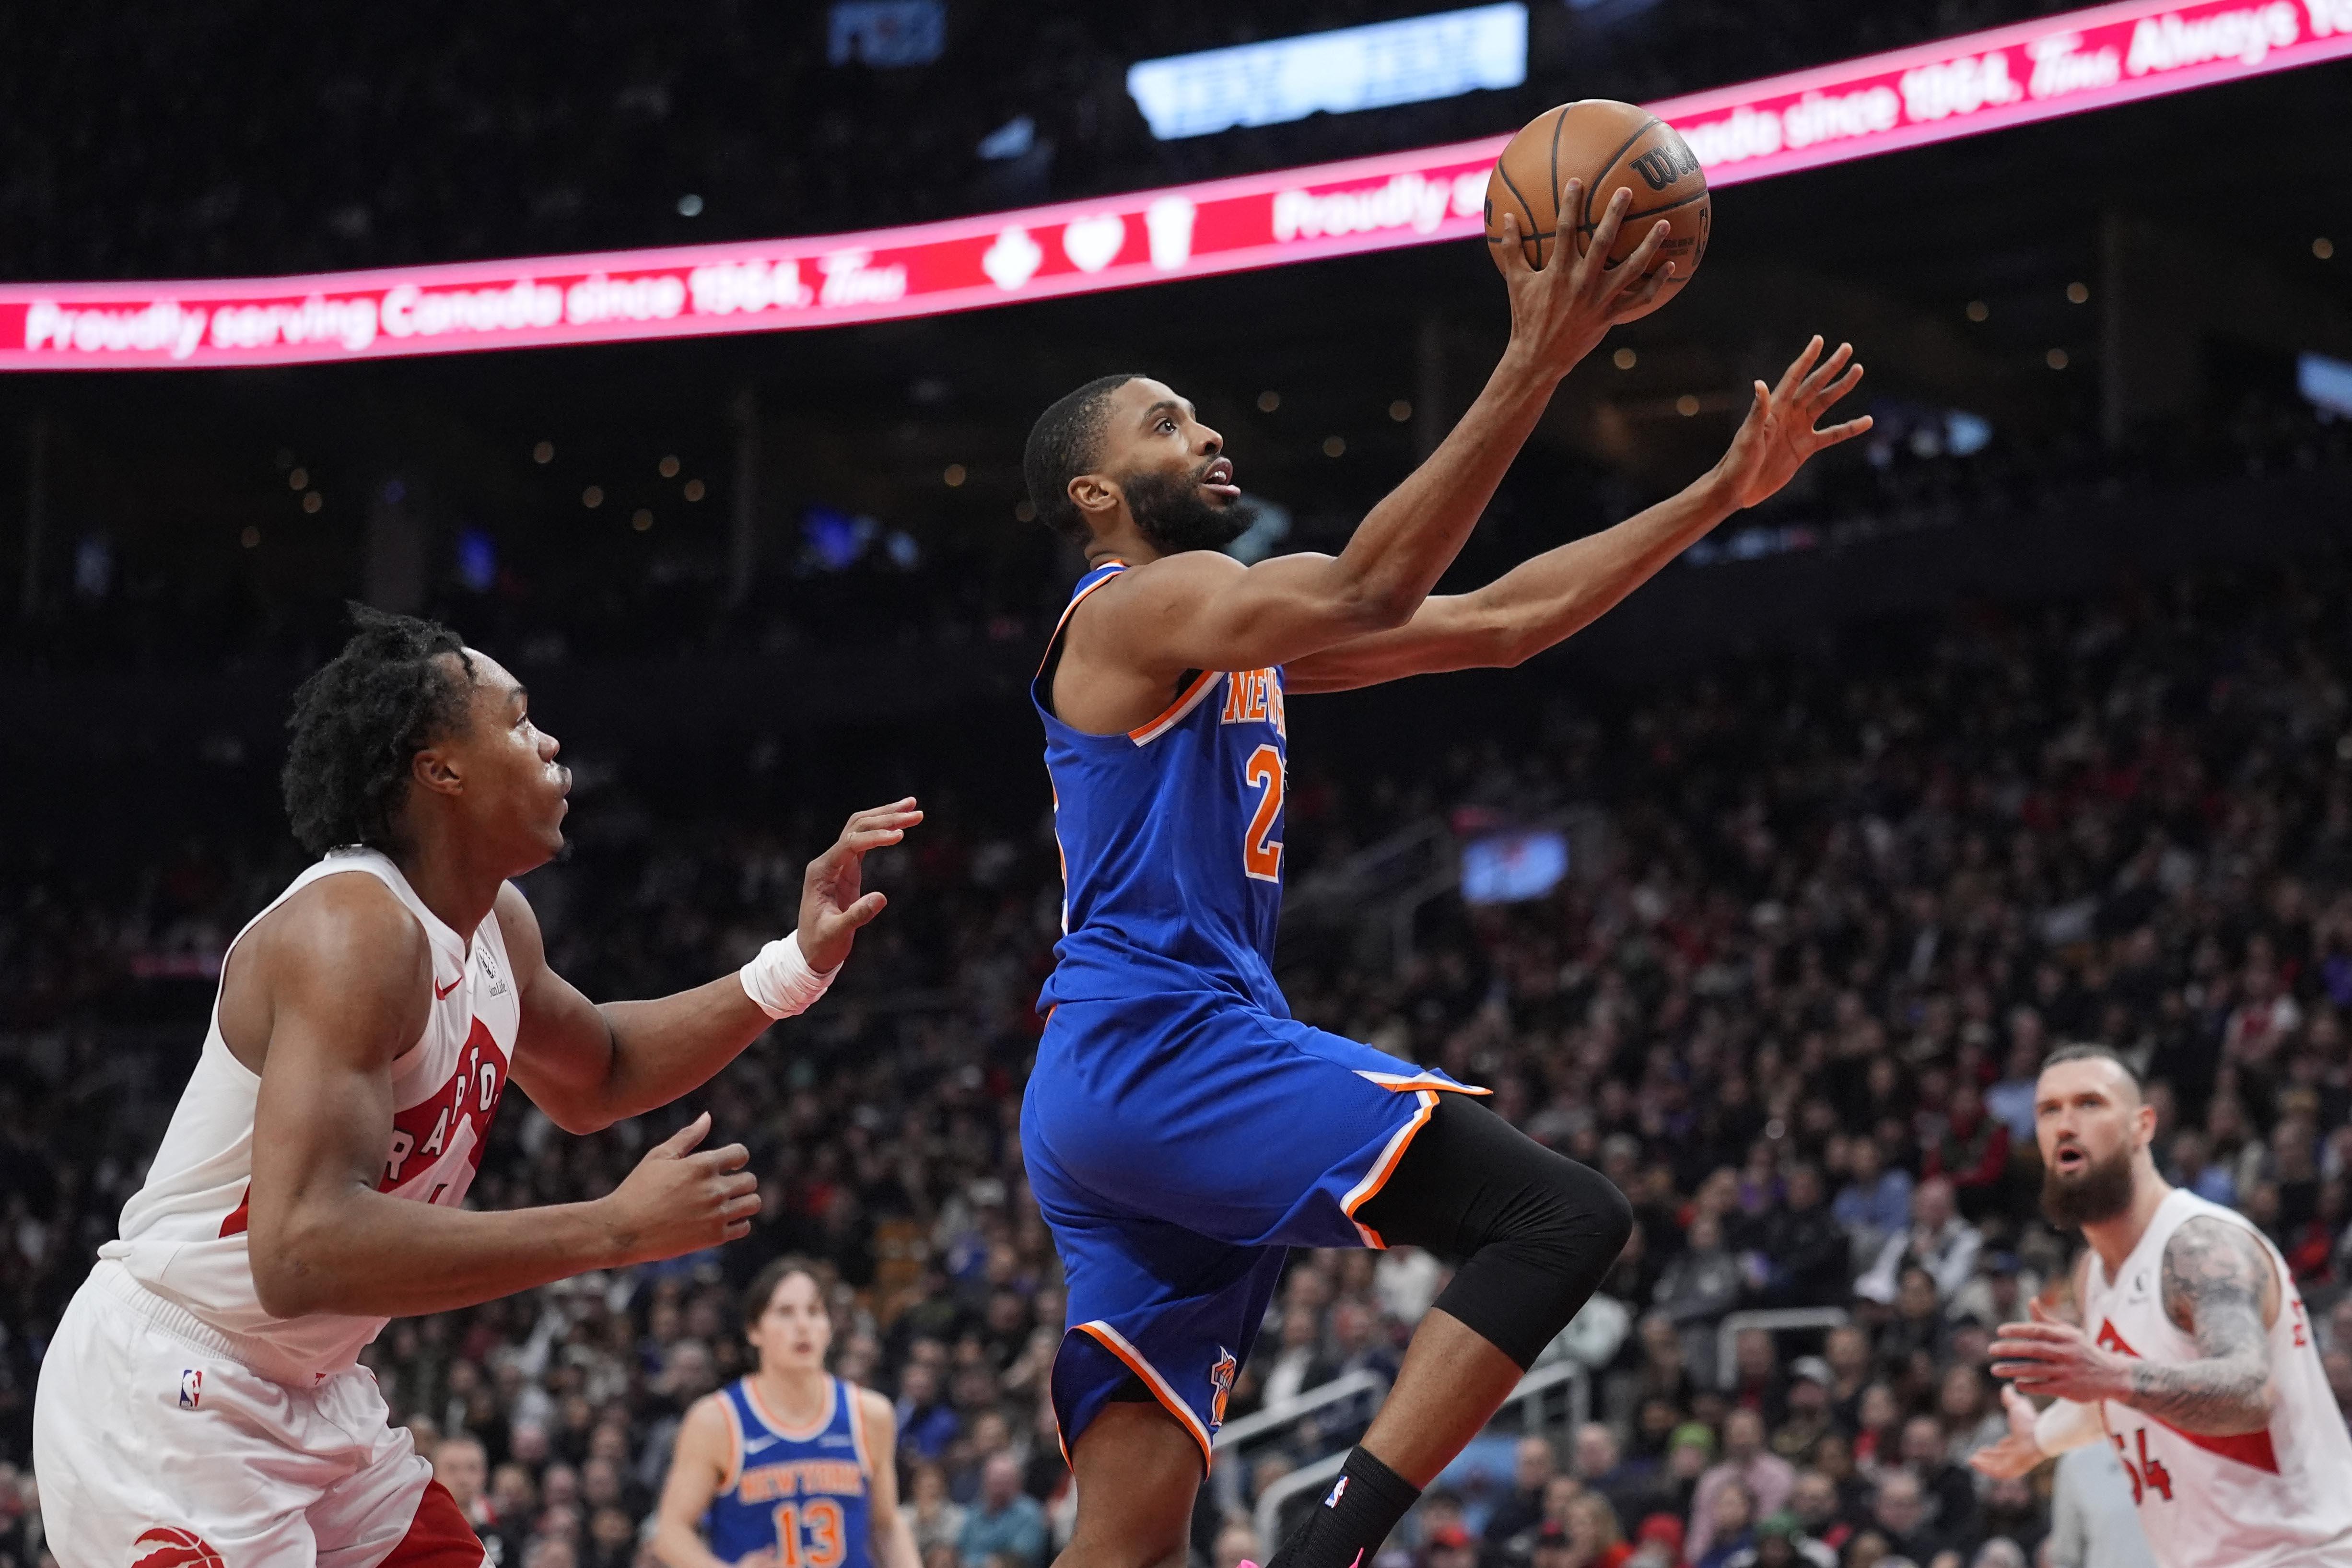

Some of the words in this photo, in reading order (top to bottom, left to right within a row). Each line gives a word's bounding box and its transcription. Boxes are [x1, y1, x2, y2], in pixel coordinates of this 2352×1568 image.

[1275, 174, 1446, 242] Proudly
[1784, 91, 1899, 149] since
[2127, 2, 2298, 75] Always
[26, 299, 206, 359] Proudly
[211, 291, 376, 350] serving
[382, 277, 562, 337] Canada
[567, 271, 685, 324] since
[386, 1046, 499, 1181] RAPTO
[773, 1499, 845, 1568] 13
